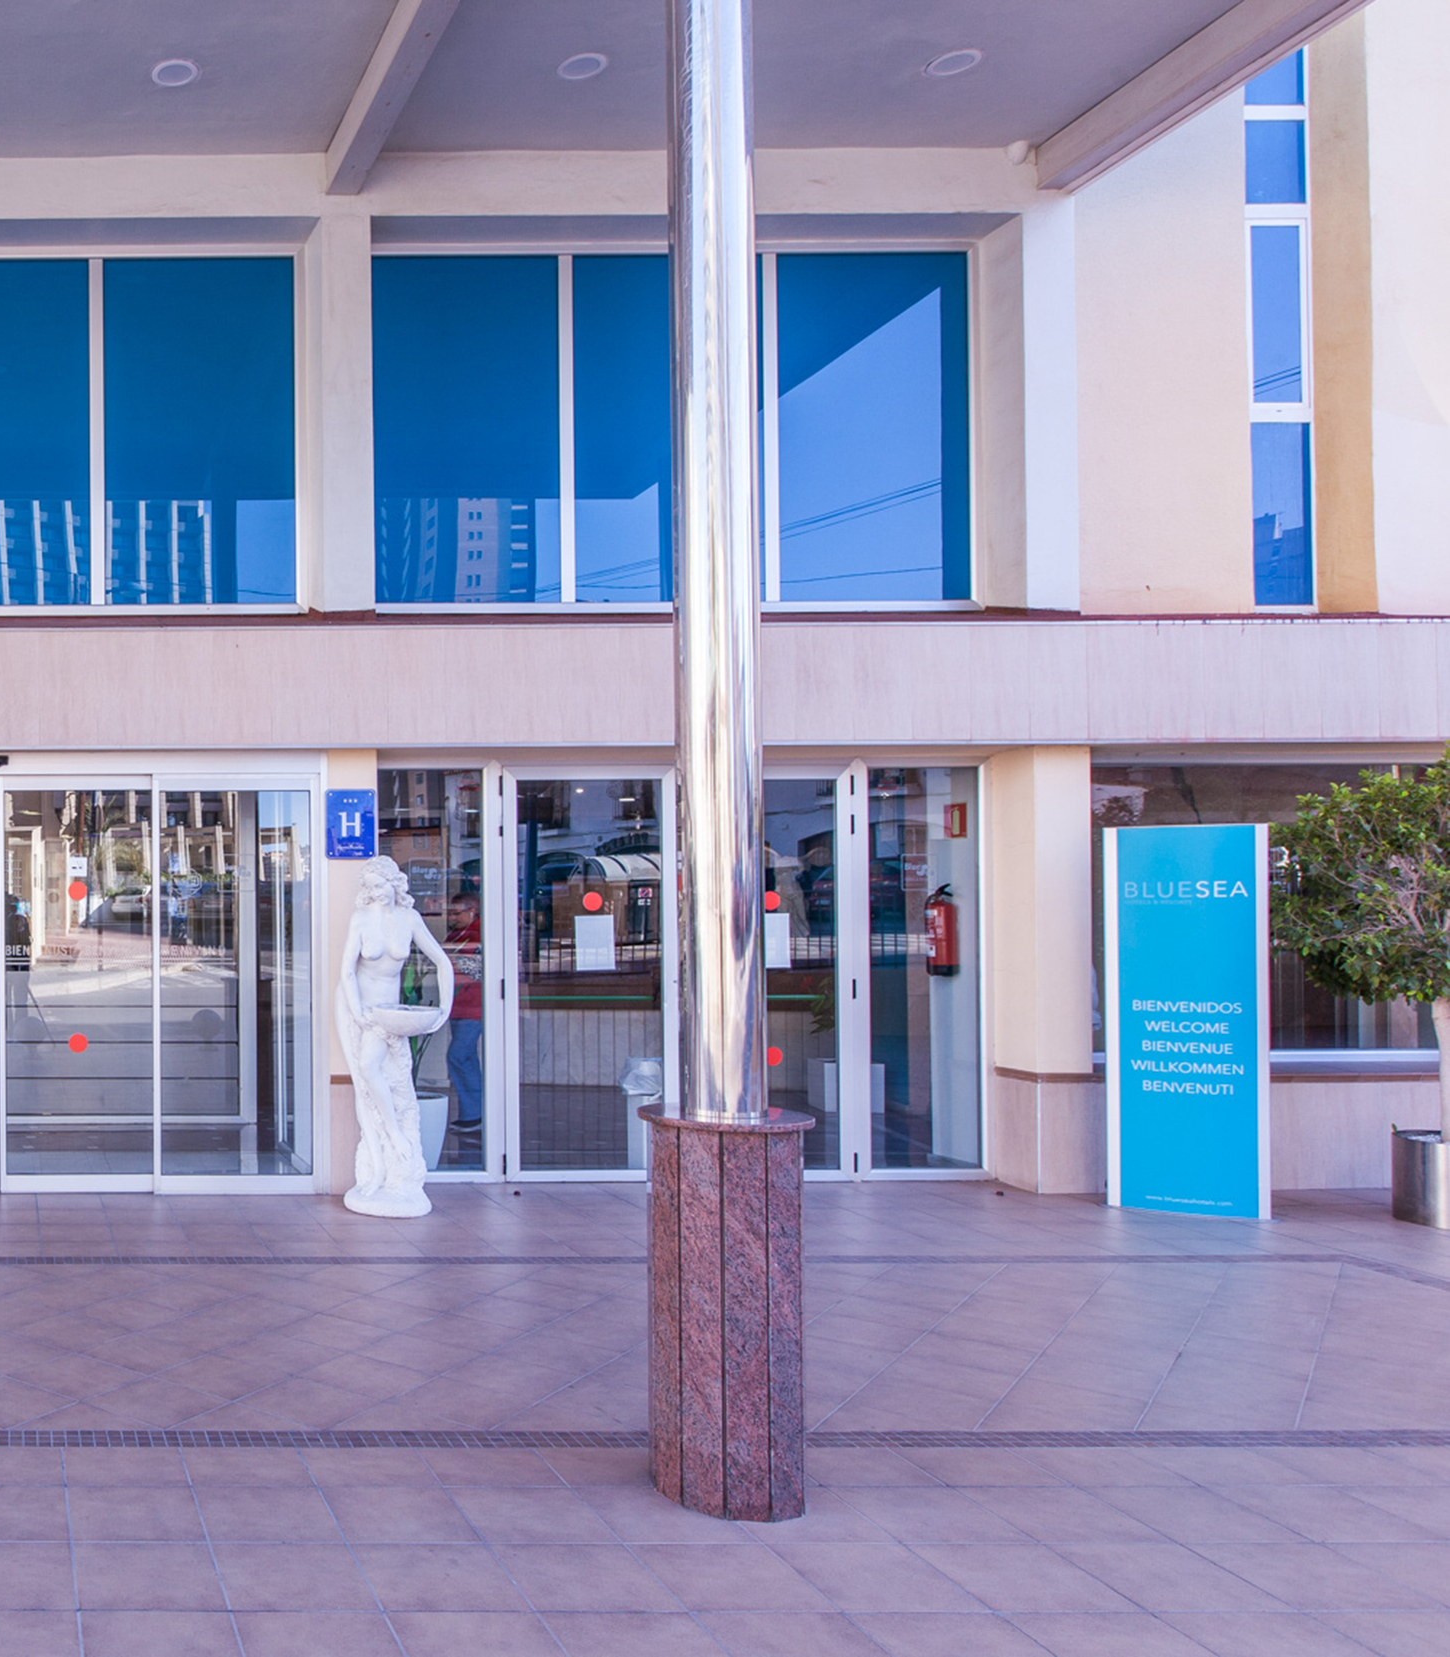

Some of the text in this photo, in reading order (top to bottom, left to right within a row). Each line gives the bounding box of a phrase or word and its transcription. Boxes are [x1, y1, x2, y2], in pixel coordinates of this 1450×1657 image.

[338, 811, 361, 838] H
[1132, 999, 1242, 1014] BIENVENIDOS
[1144, 1020, 1230, 1034] WELCOME
[1142, 1039, 1233, 1055] BIENVENUE
[1130, 1059, 1244, 1075] WILLKOMMEN
[1142, 1079, 1234, 1095] BENVENUTI
